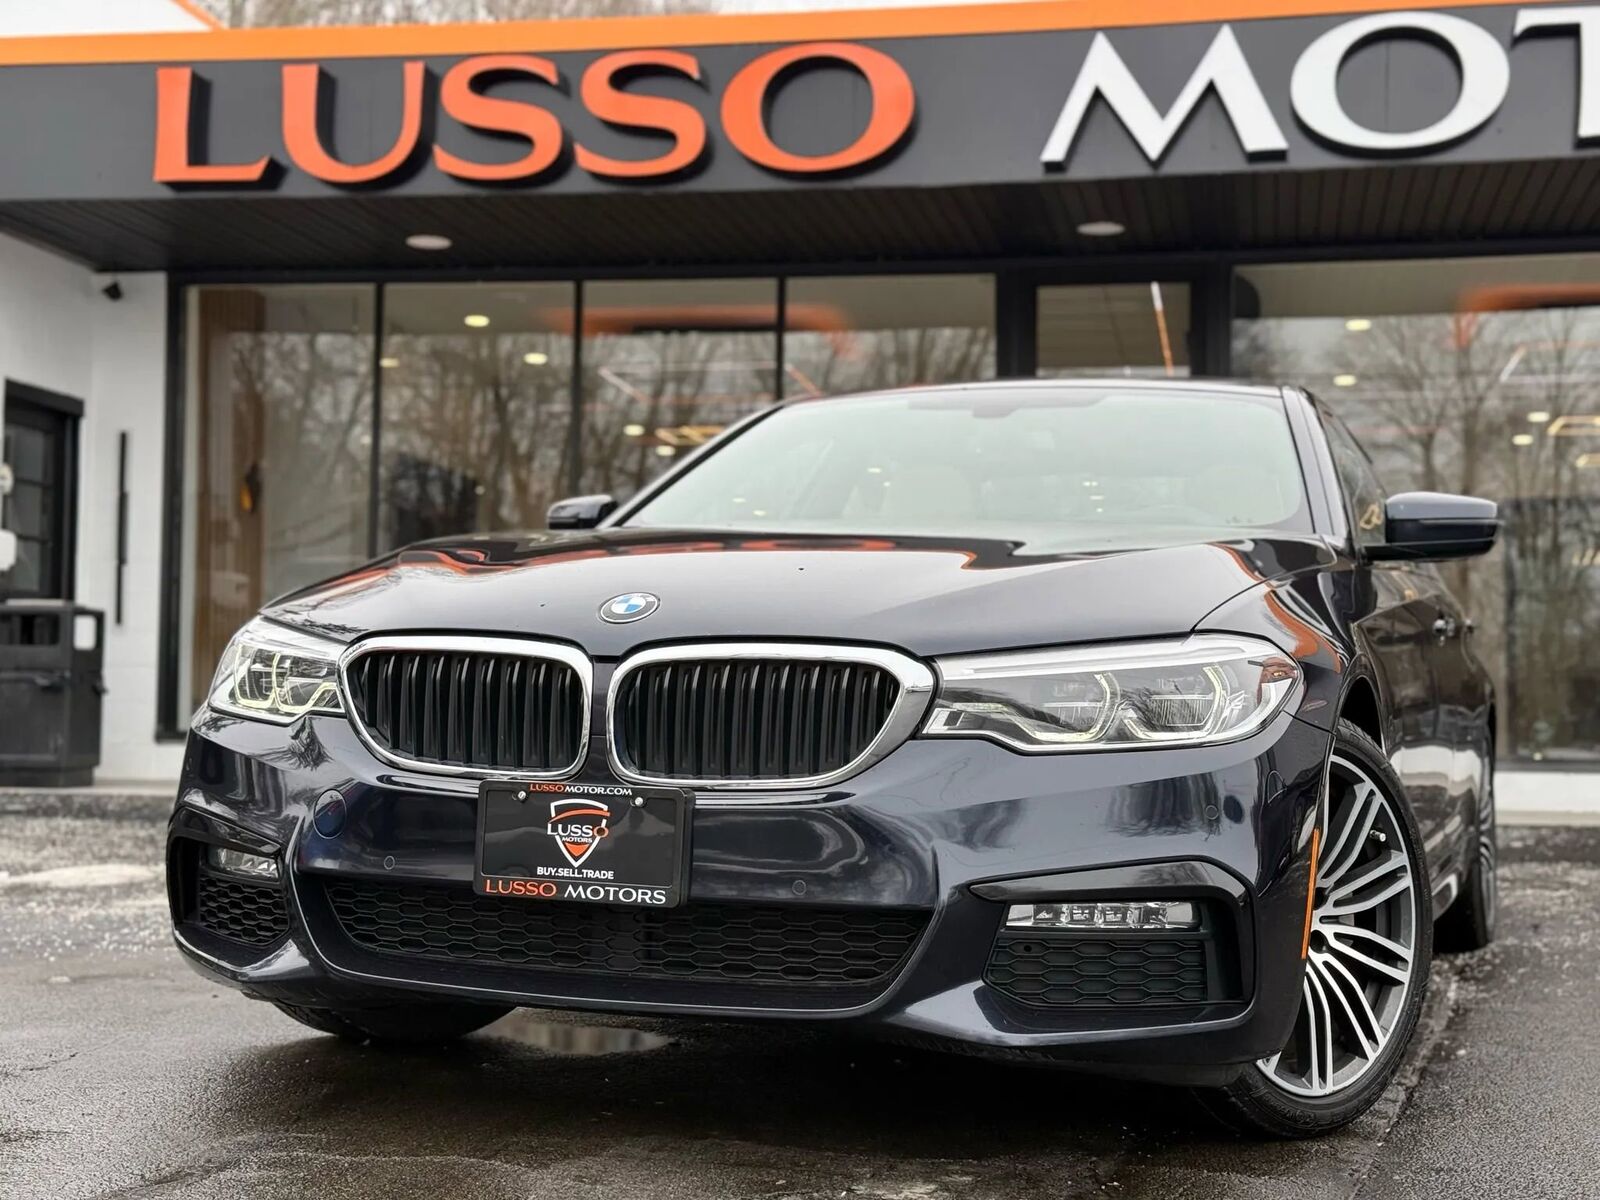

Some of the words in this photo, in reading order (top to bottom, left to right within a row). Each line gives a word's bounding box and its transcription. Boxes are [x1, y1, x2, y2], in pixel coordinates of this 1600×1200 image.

[153, 43, 916, 184] LUSSO
[529, 783, 633, 796] LUSSOMOTOR.COM
[546, 823, 610, 838] LUSSO
[561, 836, 593, 844] MOTORS
[536, 866, 615, 880] BUY.SELL.TRADE
[485, 879, 557, 897] LUSSO
[564, 884, 666, 905] MOTORS
